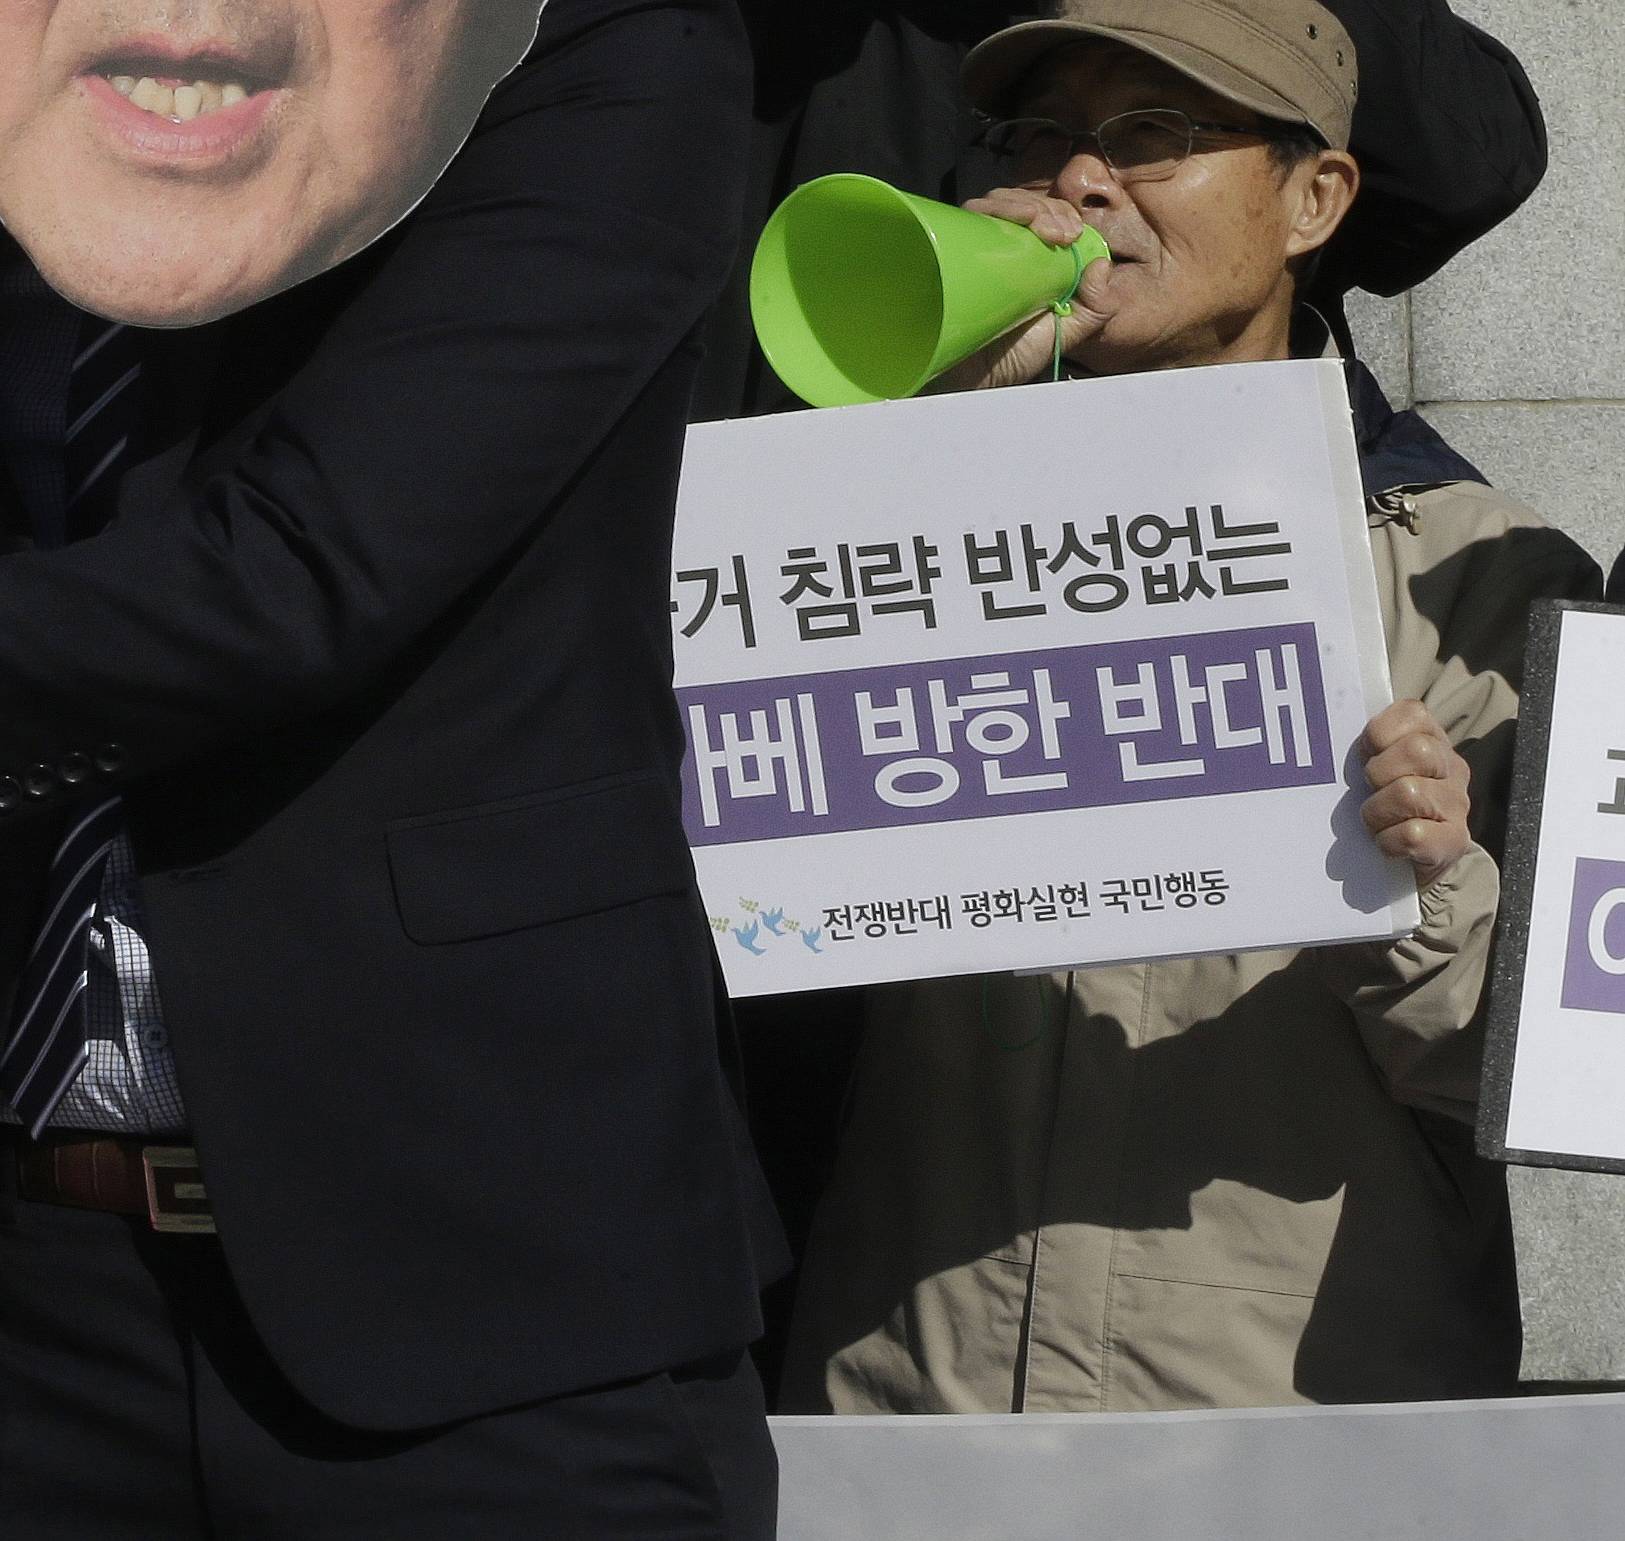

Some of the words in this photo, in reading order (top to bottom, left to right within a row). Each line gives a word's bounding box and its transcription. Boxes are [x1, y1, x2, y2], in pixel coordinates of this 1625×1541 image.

[670, 554, 757, 648] 거
[779, 533, 942, 642] 침략
[963, 503, 1293, 620] 반성없는
[856, 669, 1071, 809] 방한
[1095, 642, 1313, 781] 반대
[821, 895, 953, 943] 전쟁반대
[960, 881, 1092, 927] 평화실현
[1099, 869, 1231, 913] 국민행동
